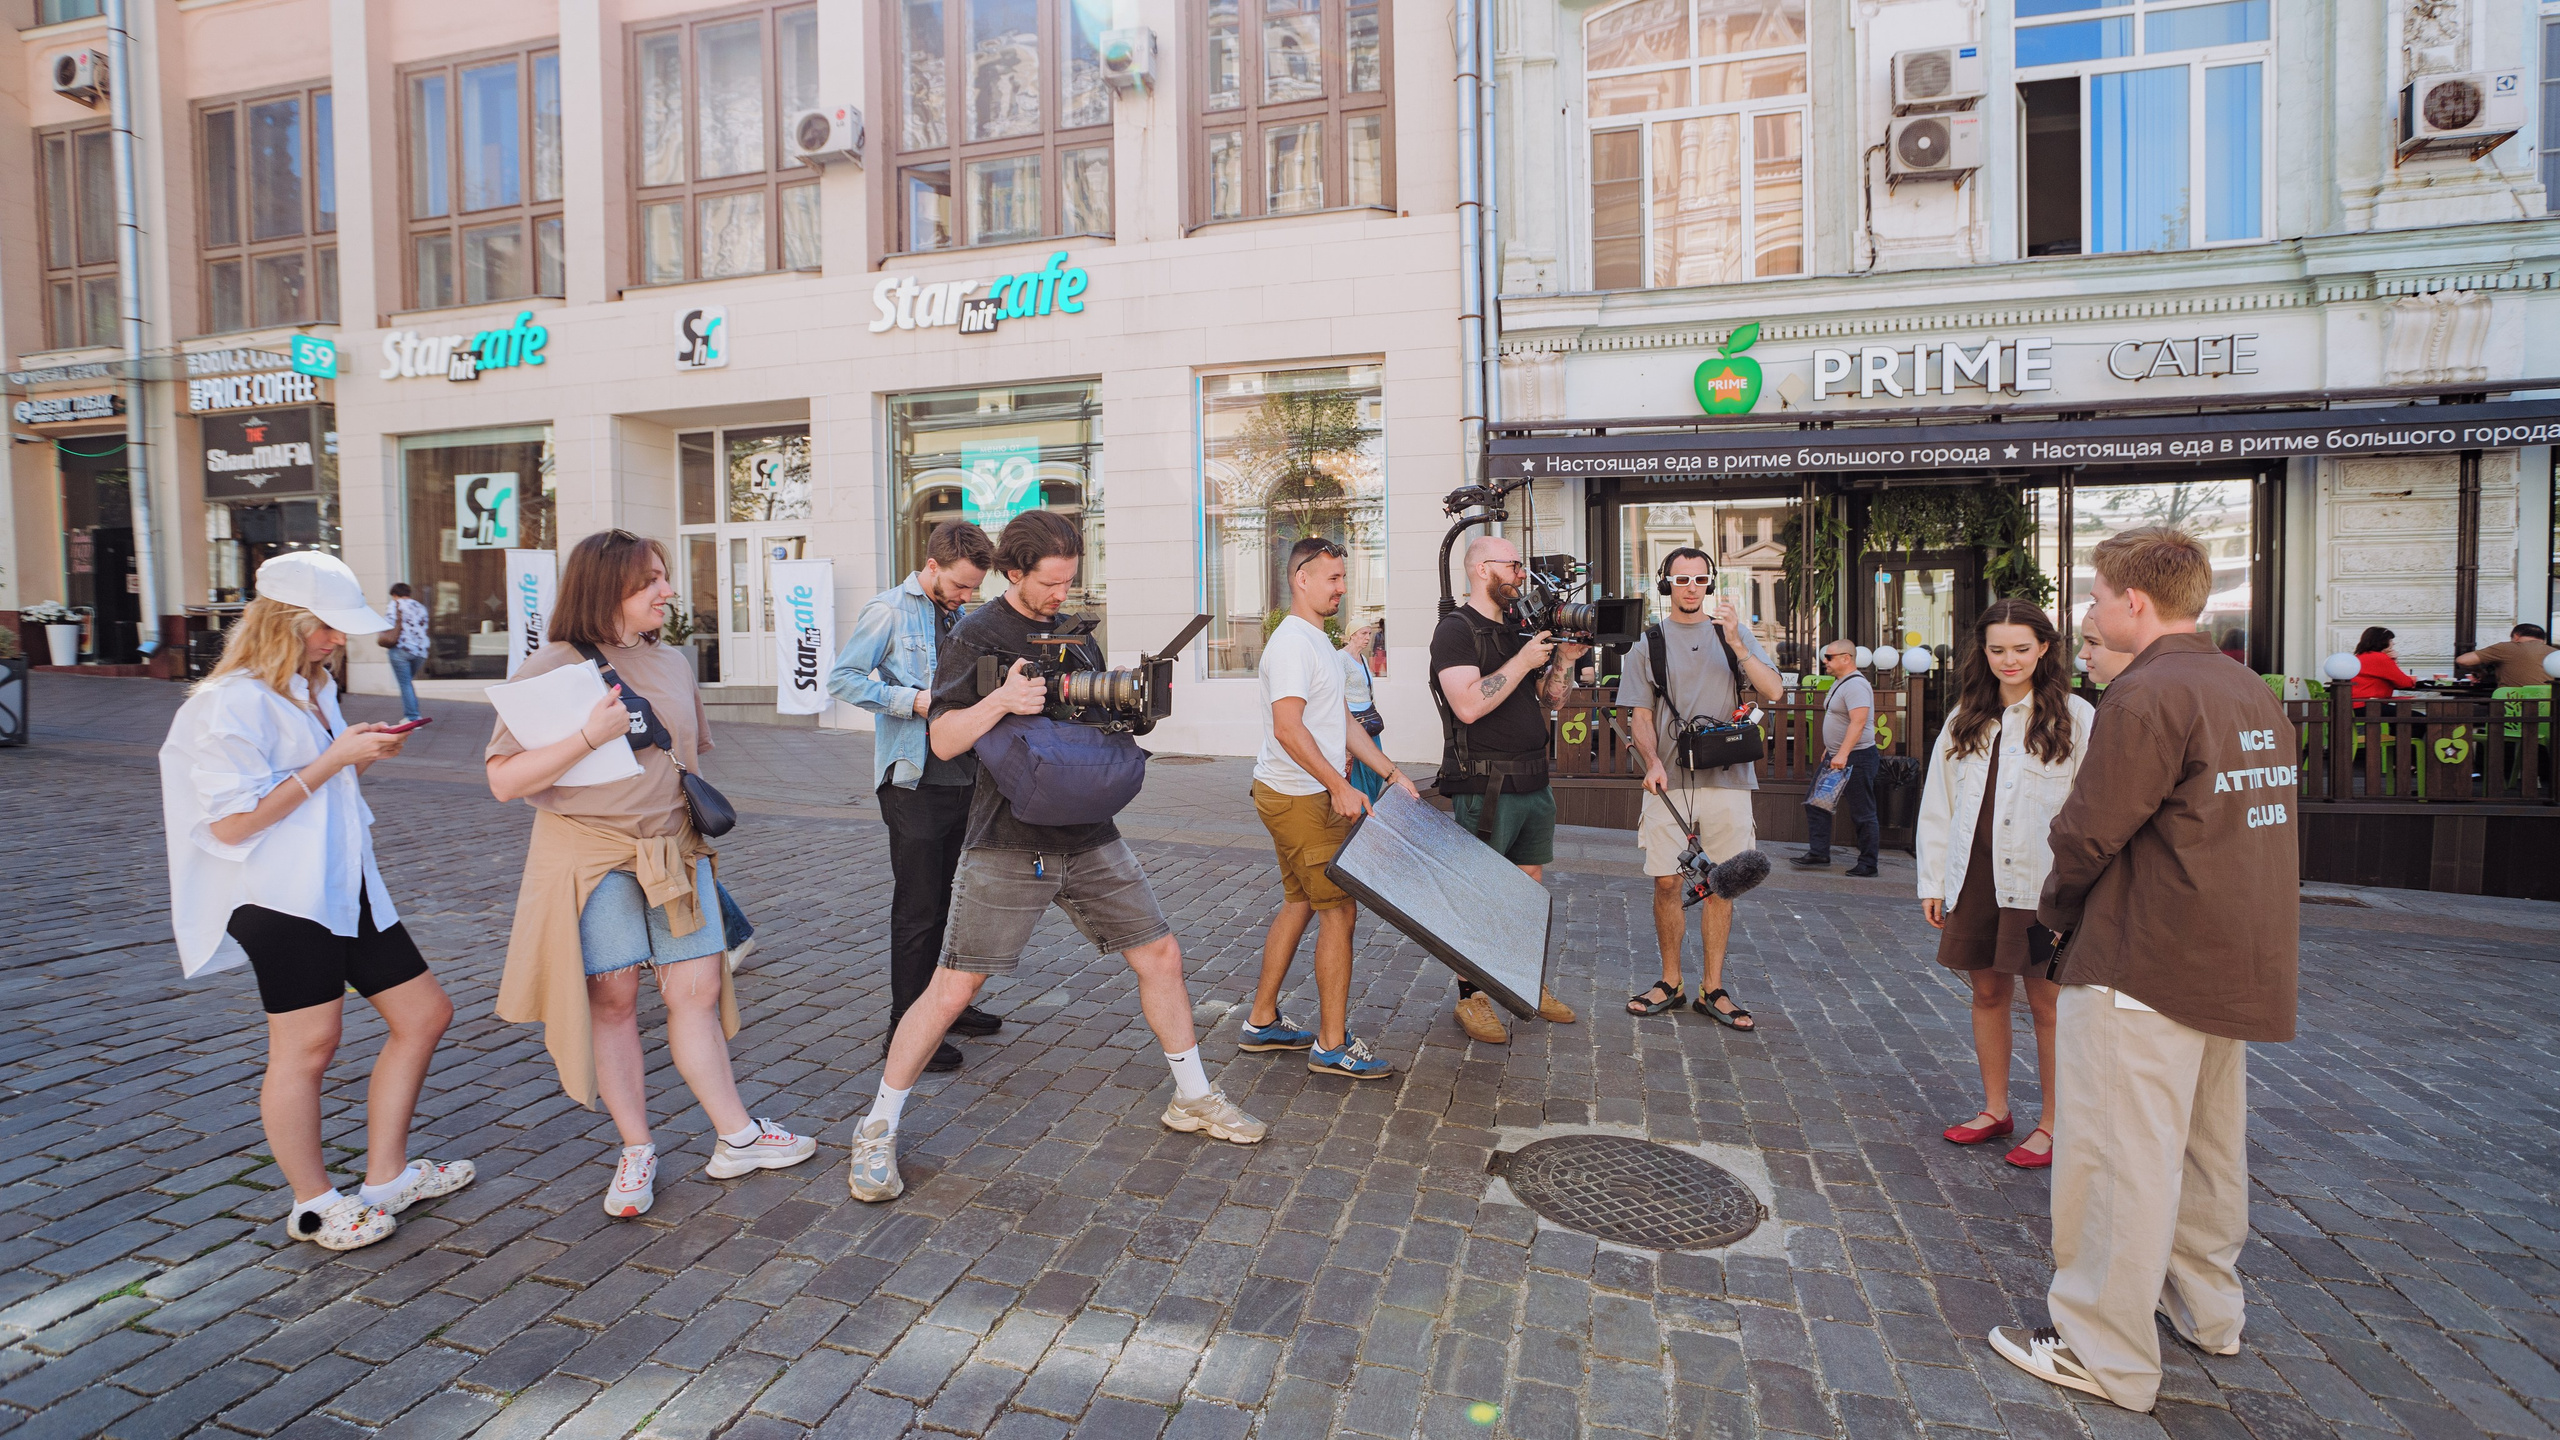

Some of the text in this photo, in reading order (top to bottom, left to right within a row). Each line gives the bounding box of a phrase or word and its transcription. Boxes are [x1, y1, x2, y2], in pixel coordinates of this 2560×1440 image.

[868, 250, 1088, 333] Star hit cafe
[299, 342, 334, 368] 59
[379, 310, 548, 381] Star hit cafe
[1707, 378, 1748, 391] PRIME
[1813, 333, 2259, 401] PRIME CAFE
[190, 379, 202, 410] ONE
[201, 370, 317, 410] PRICE COFFEE
[245, 426, 268, 443] THE
[980, 444, 1021, 453] меню от
[1546, 424, 2560, 473] Настоящая еда в ритме большого города Настоящая еда в ритме большого города
[968, 456, 1034, 505] 59
[518, 572, 538, 618] cafe
[523, 622, 541, 661] tar
[785, 584, 820, 692] Star hit cafe
[2247, 803, 2287, 829] CLUB
